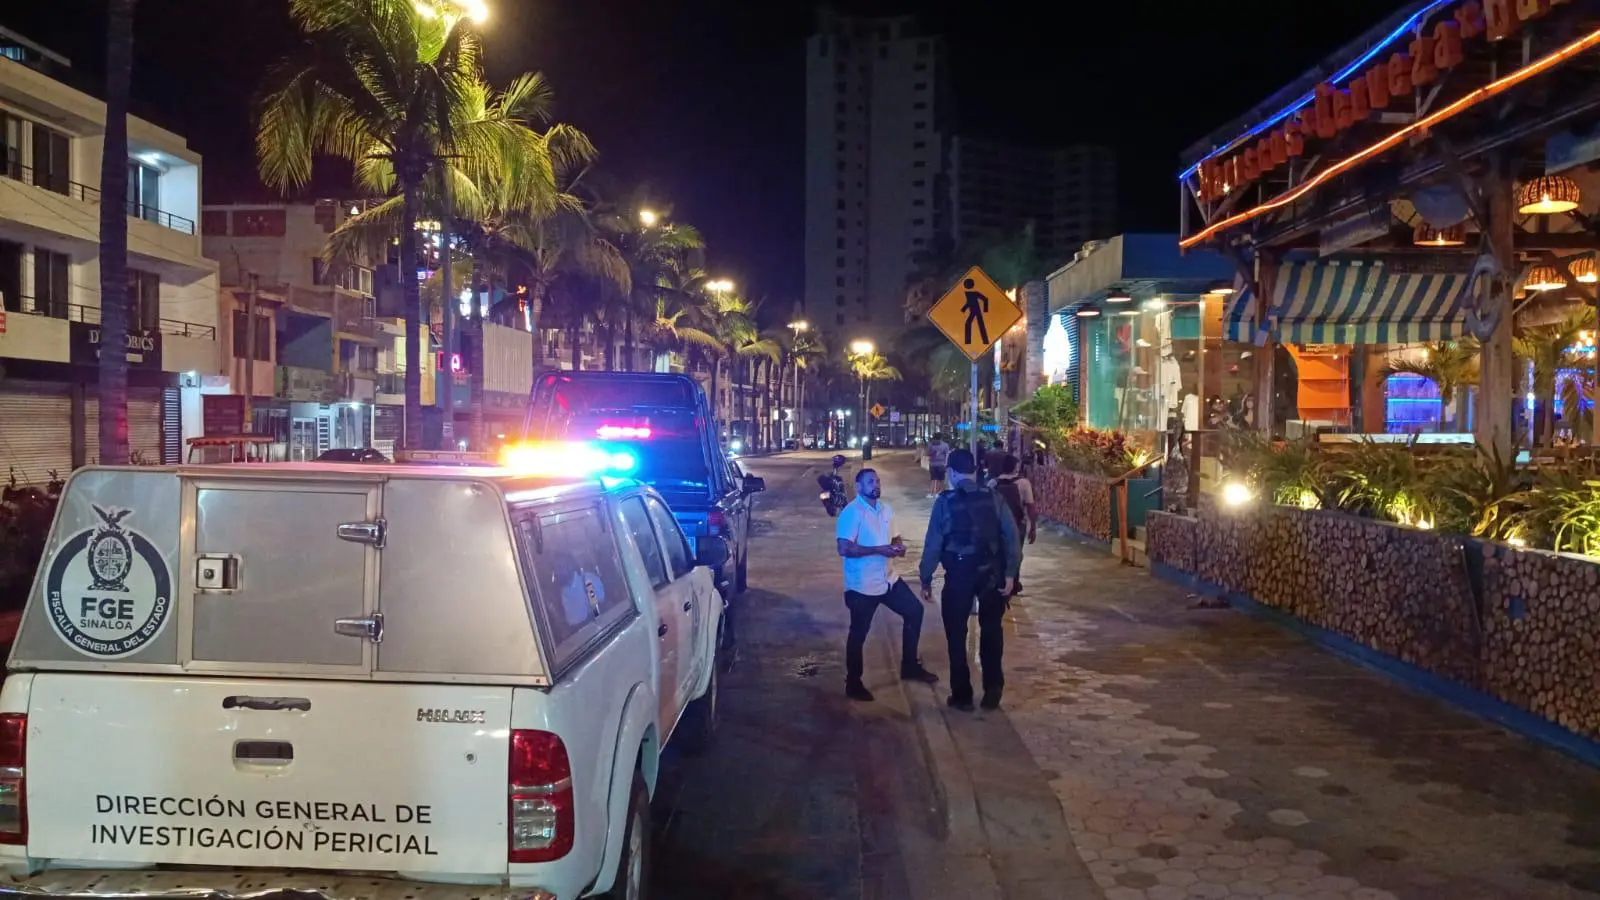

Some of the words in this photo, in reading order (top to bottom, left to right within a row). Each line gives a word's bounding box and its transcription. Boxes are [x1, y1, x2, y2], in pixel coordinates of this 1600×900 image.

[51, 591, 73, 637] FISCALÍA
[74, 634, 121, 652] GENERAL
[123, 636, 144, 650] DEL
[142, 596, 166, 636] ESTADO
[80, 597, 135, 620] FGE
[80, 618, 133, 630] SINALOA
[417, 708, 486, 724] HILUX
[96, 794, 245, 818] DIRECCIÓN
[255, 800, 386, 822] GENERAL
[395, 804, 432, 824] DE
[92, 823, 303, 850] INVESTIGACIÓN
[314, 831, 438, 855] PERICIAL
